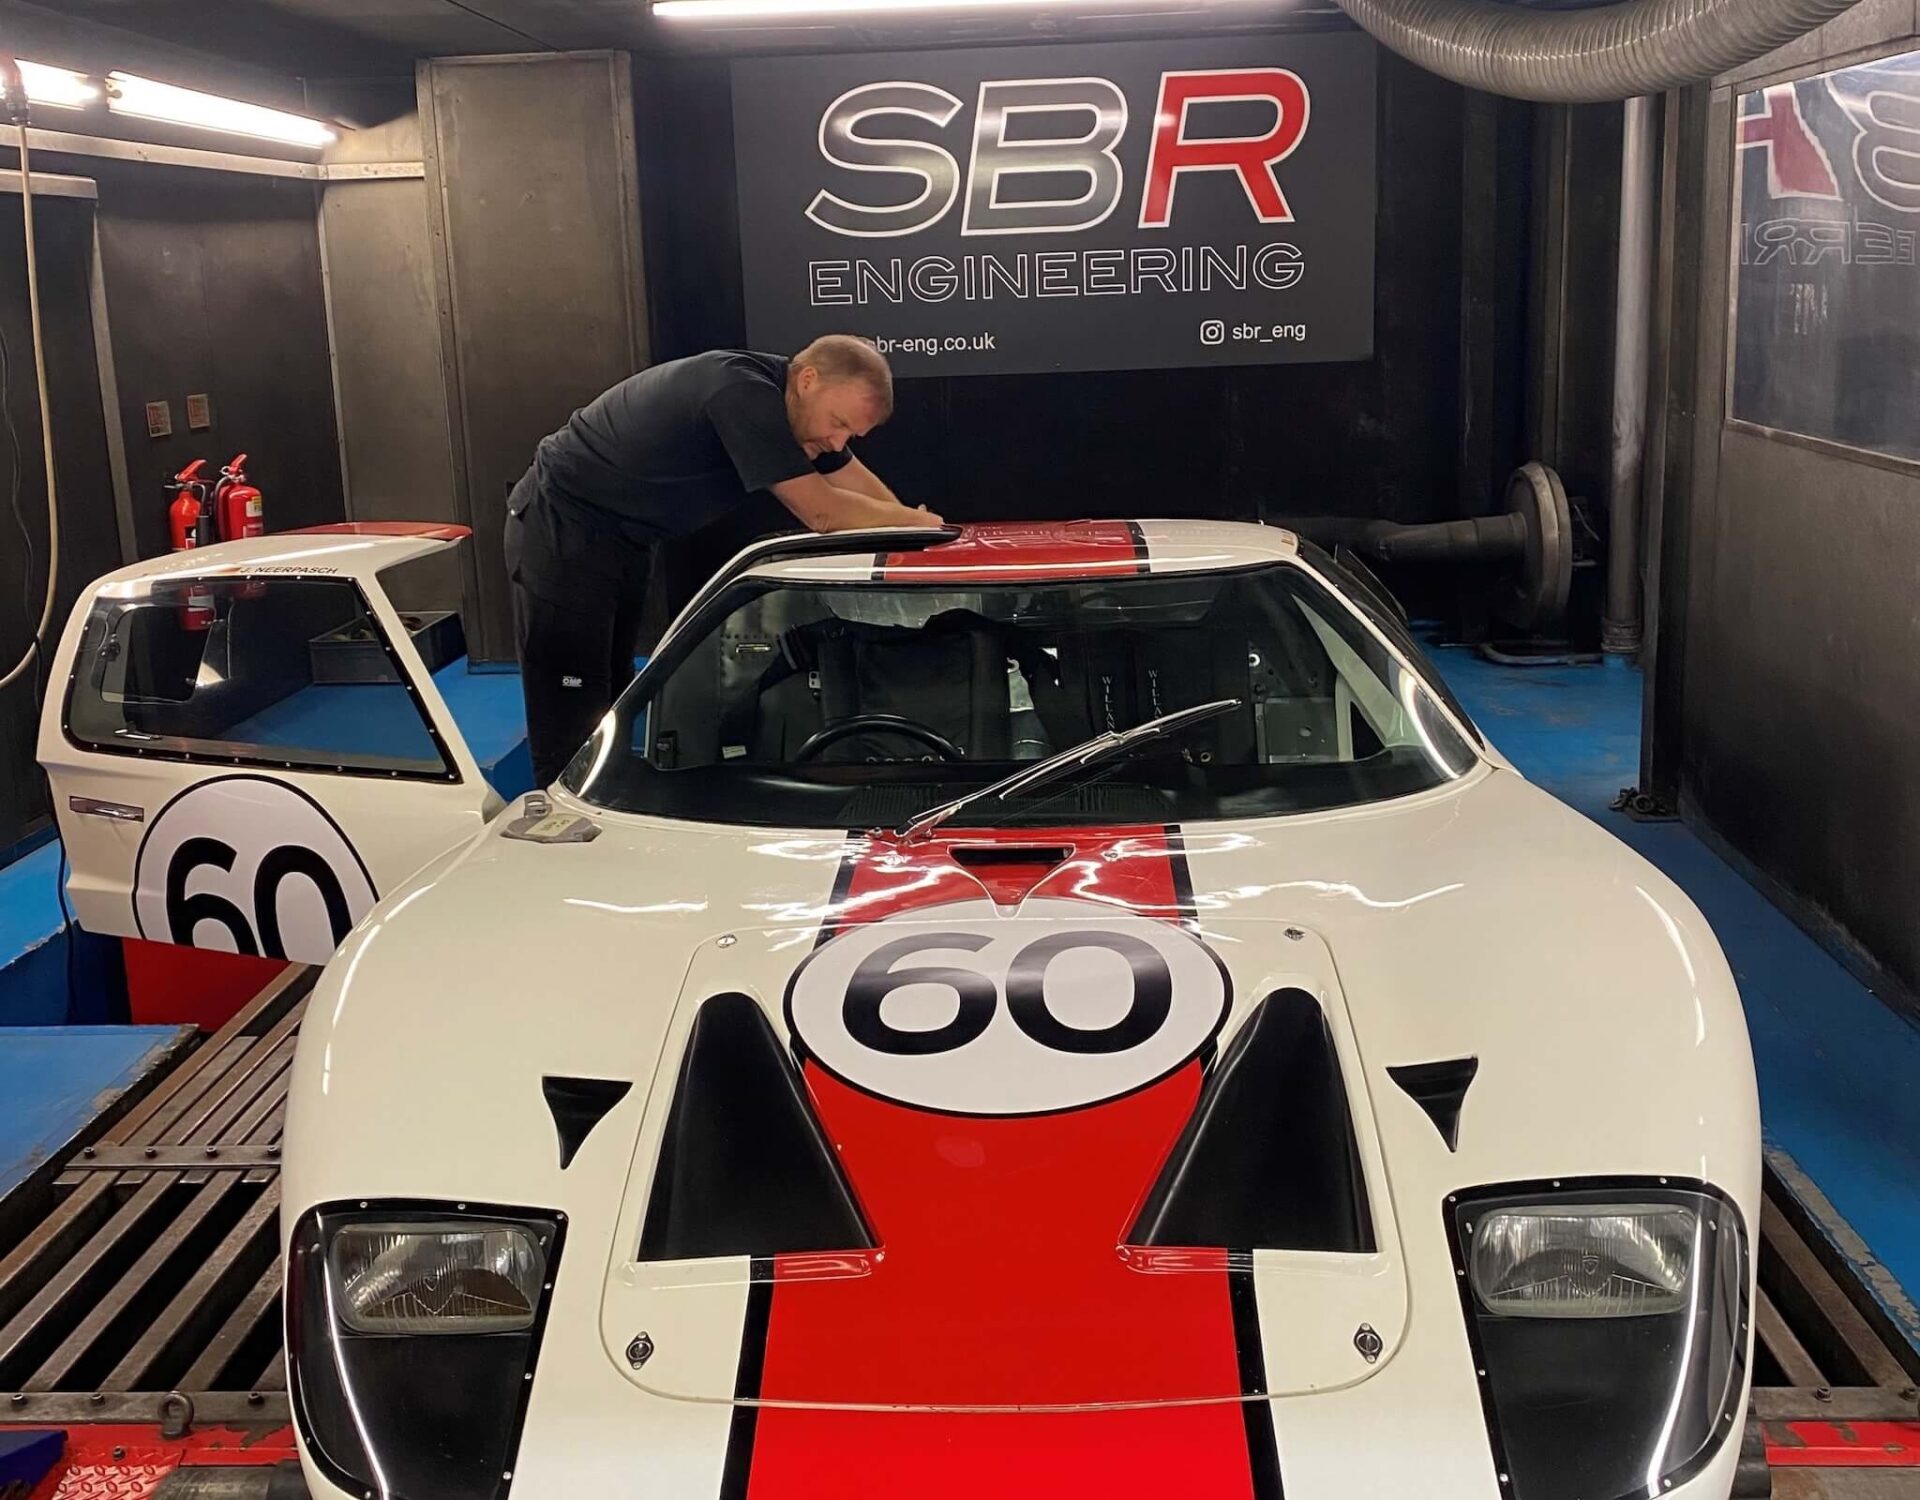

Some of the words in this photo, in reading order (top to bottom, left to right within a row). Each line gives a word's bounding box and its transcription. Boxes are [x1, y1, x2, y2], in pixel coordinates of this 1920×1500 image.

[804, 66, 1311, 237] SBR
[808, 242, 1306, 306] ENGINEERING
[1231, 322, 1307, 343] sbr_eng
[255, 566, 339, 575] NEERPASCH
[842, 930, 1172, 1055] 60
